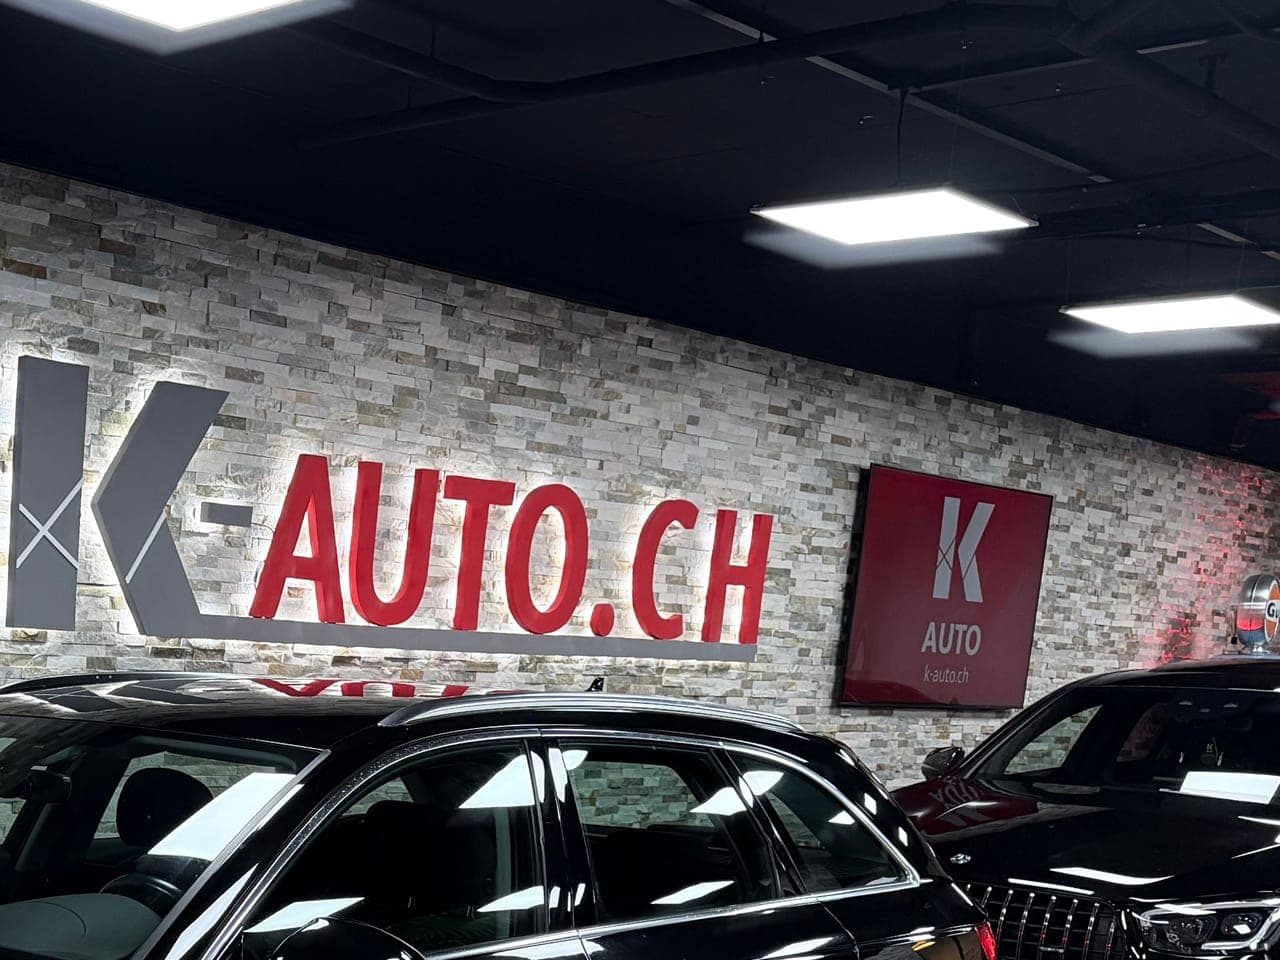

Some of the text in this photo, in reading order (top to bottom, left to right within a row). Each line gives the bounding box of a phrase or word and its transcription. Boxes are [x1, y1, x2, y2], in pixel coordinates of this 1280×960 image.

[6, 355, 774, 646] K-AUTO.CH
[933, 496, 995, 603] K
[921, 621, 982, 656] AUTO
[923, 664, 969, 684] k-auto.ch
